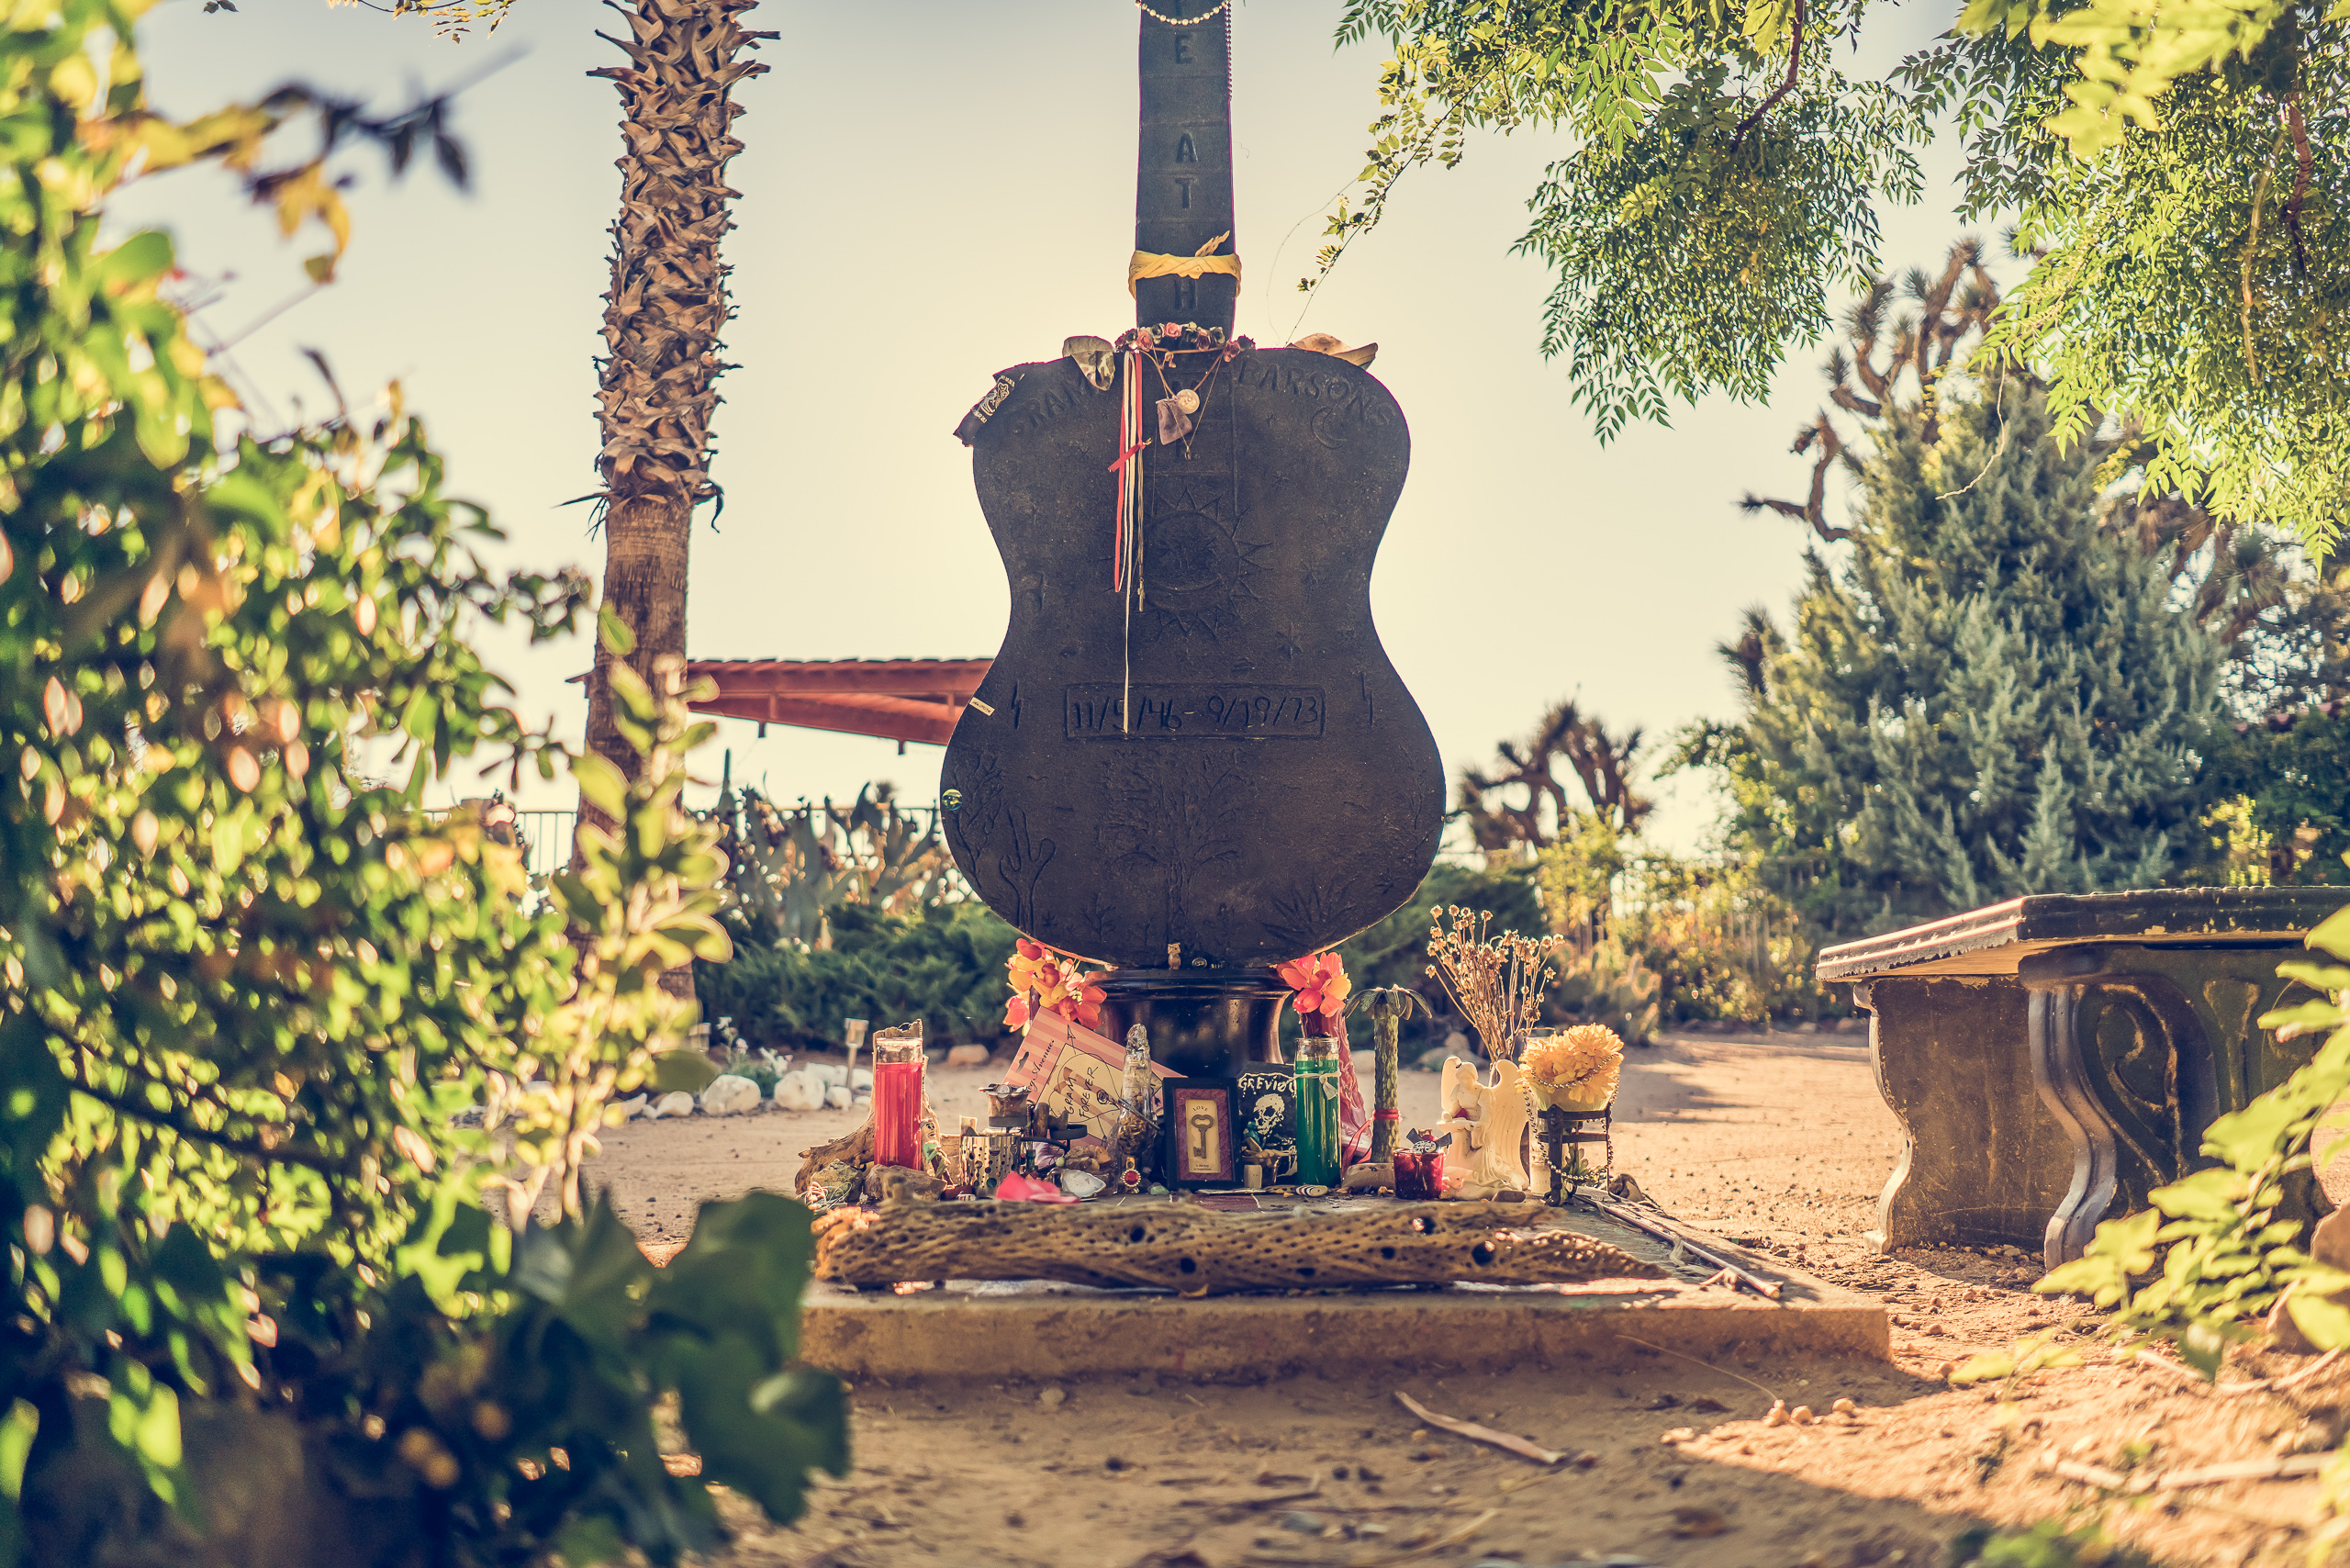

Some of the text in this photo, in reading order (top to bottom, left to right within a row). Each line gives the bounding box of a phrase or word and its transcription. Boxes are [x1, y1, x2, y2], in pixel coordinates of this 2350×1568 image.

[1238, 355, 1396, 429] PARSONS
[1207, 695, 1319, 727] 9/19/73
[1064, 1076, 1077, 1114] GRAM
[1079, 1066, 1099, 1119] FOREVER
